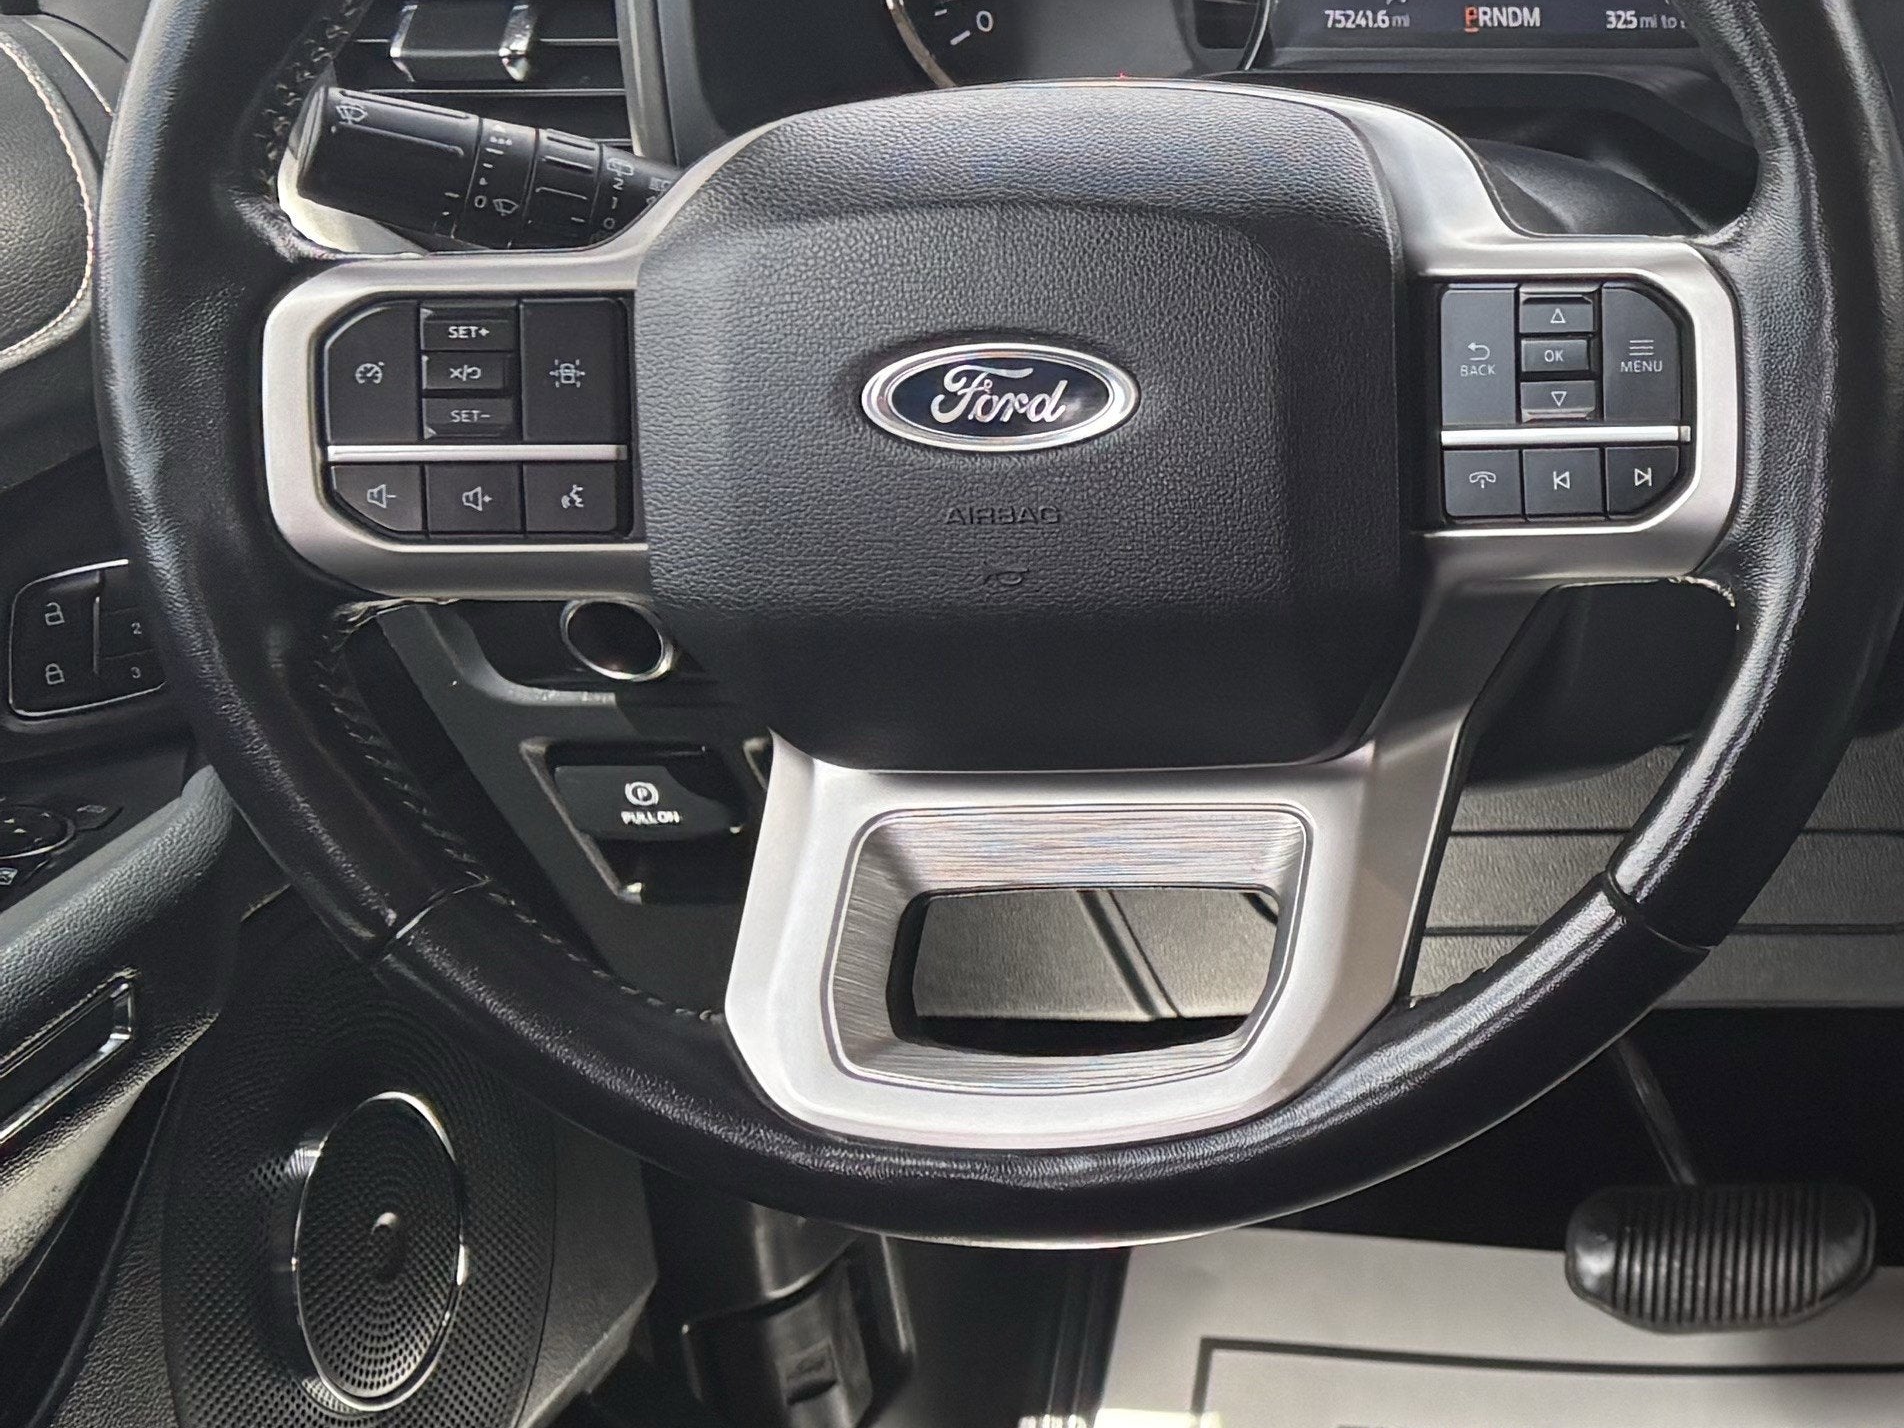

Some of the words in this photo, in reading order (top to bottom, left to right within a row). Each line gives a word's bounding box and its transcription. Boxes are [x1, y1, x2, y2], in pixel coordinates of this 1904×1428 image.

[976, 10, 994, 32] 0
[1325, 9, 1390, 29] 75241.6
[1392, 12, 1411, 29] mi
[1464, 6, 1542, 30] PRNDM
[1605, 10, 1638, 29] 325
[1639, 12, 1658, 29] mi
[1661, 13, 1677, 29] to
[612, 177, 624, 191] 2
[474, 194, 487, 209] 0
[611, 196, 618, 210] 1
[603, 217, 615, 231] 0
[448, 325, 490, 339] SET+
[1543, 349, 1564, 363] OK
[1460, 364, 1496, 377] BACK
[1620, 359, 1664, 373] MENU
[930, 364, 1069, 423] Ford
[946, 505, 1062, 525] AIRBAG
[131, 622, 142, 635] 2
[130, 666, 142, 679] 3
[621, 810, 657, 825] PULL
[657, 810, 681, 824] ON
